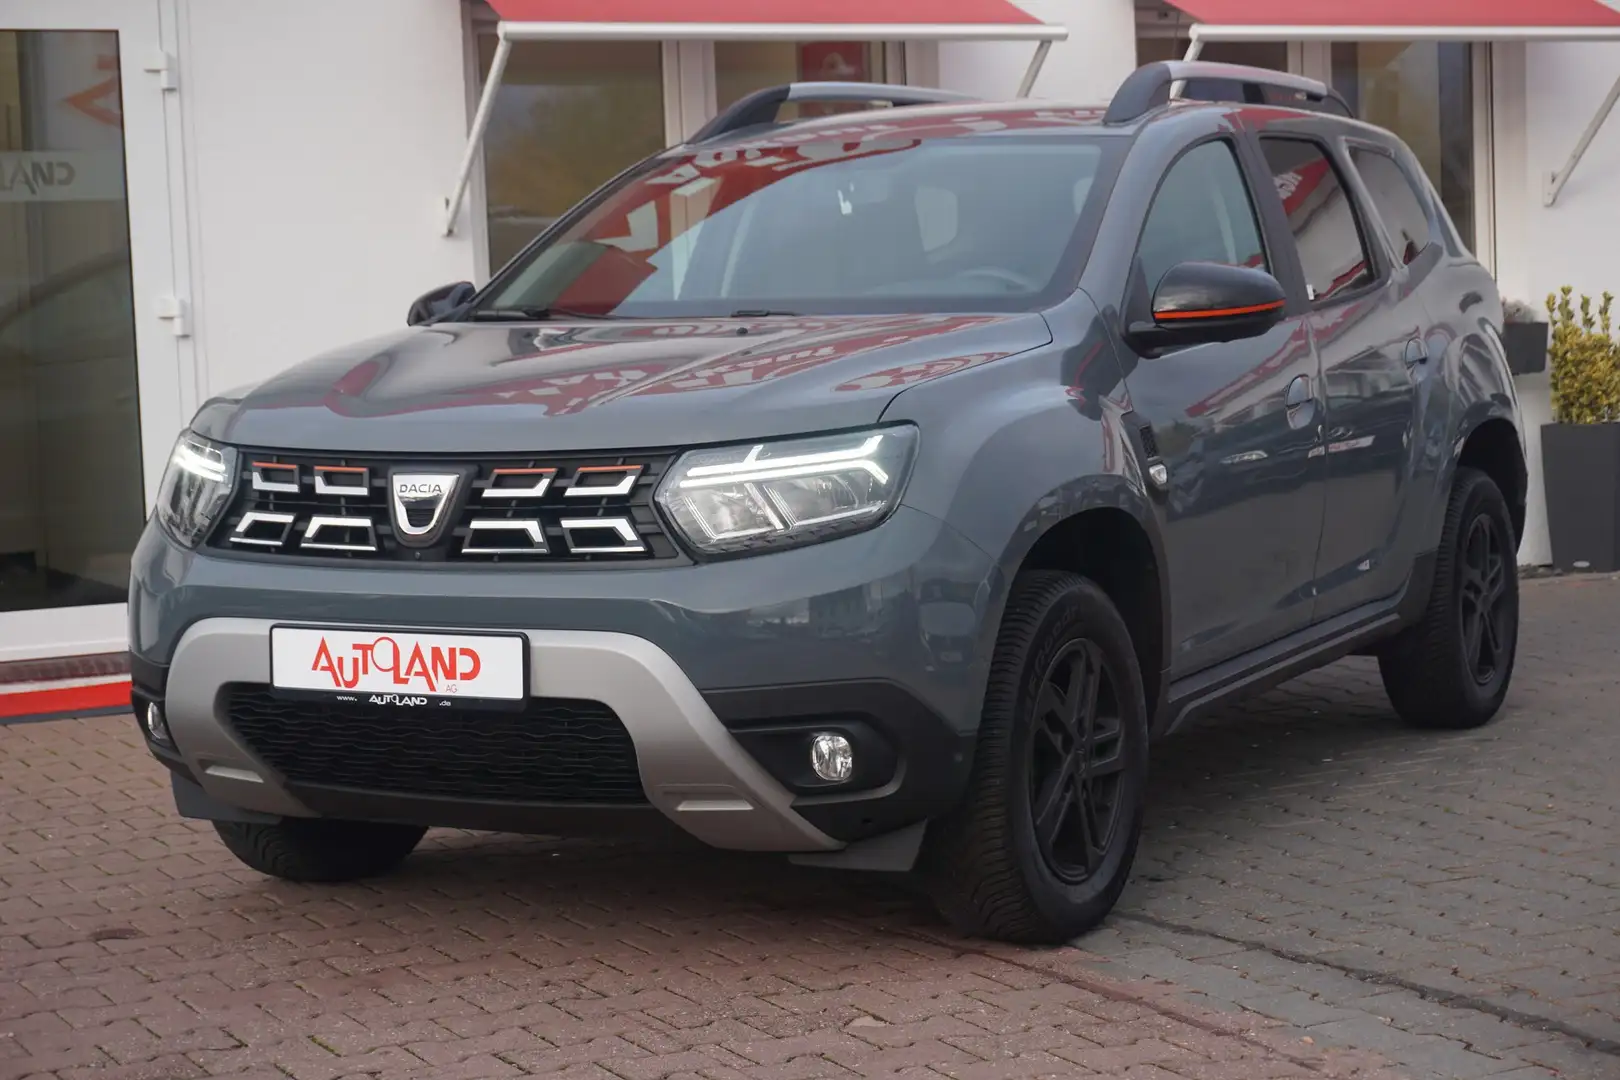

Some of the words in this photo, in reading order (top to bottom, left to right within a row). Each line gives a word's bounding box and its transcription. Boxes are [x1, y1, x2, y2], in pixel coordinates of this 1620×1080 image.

[399, 484, 442, 493] DACIA
[311, 636, 482, 692] AUTOLAND
[445, 684, 458, 693] AG
[369, 694, 428, 706] AUTOLAND
